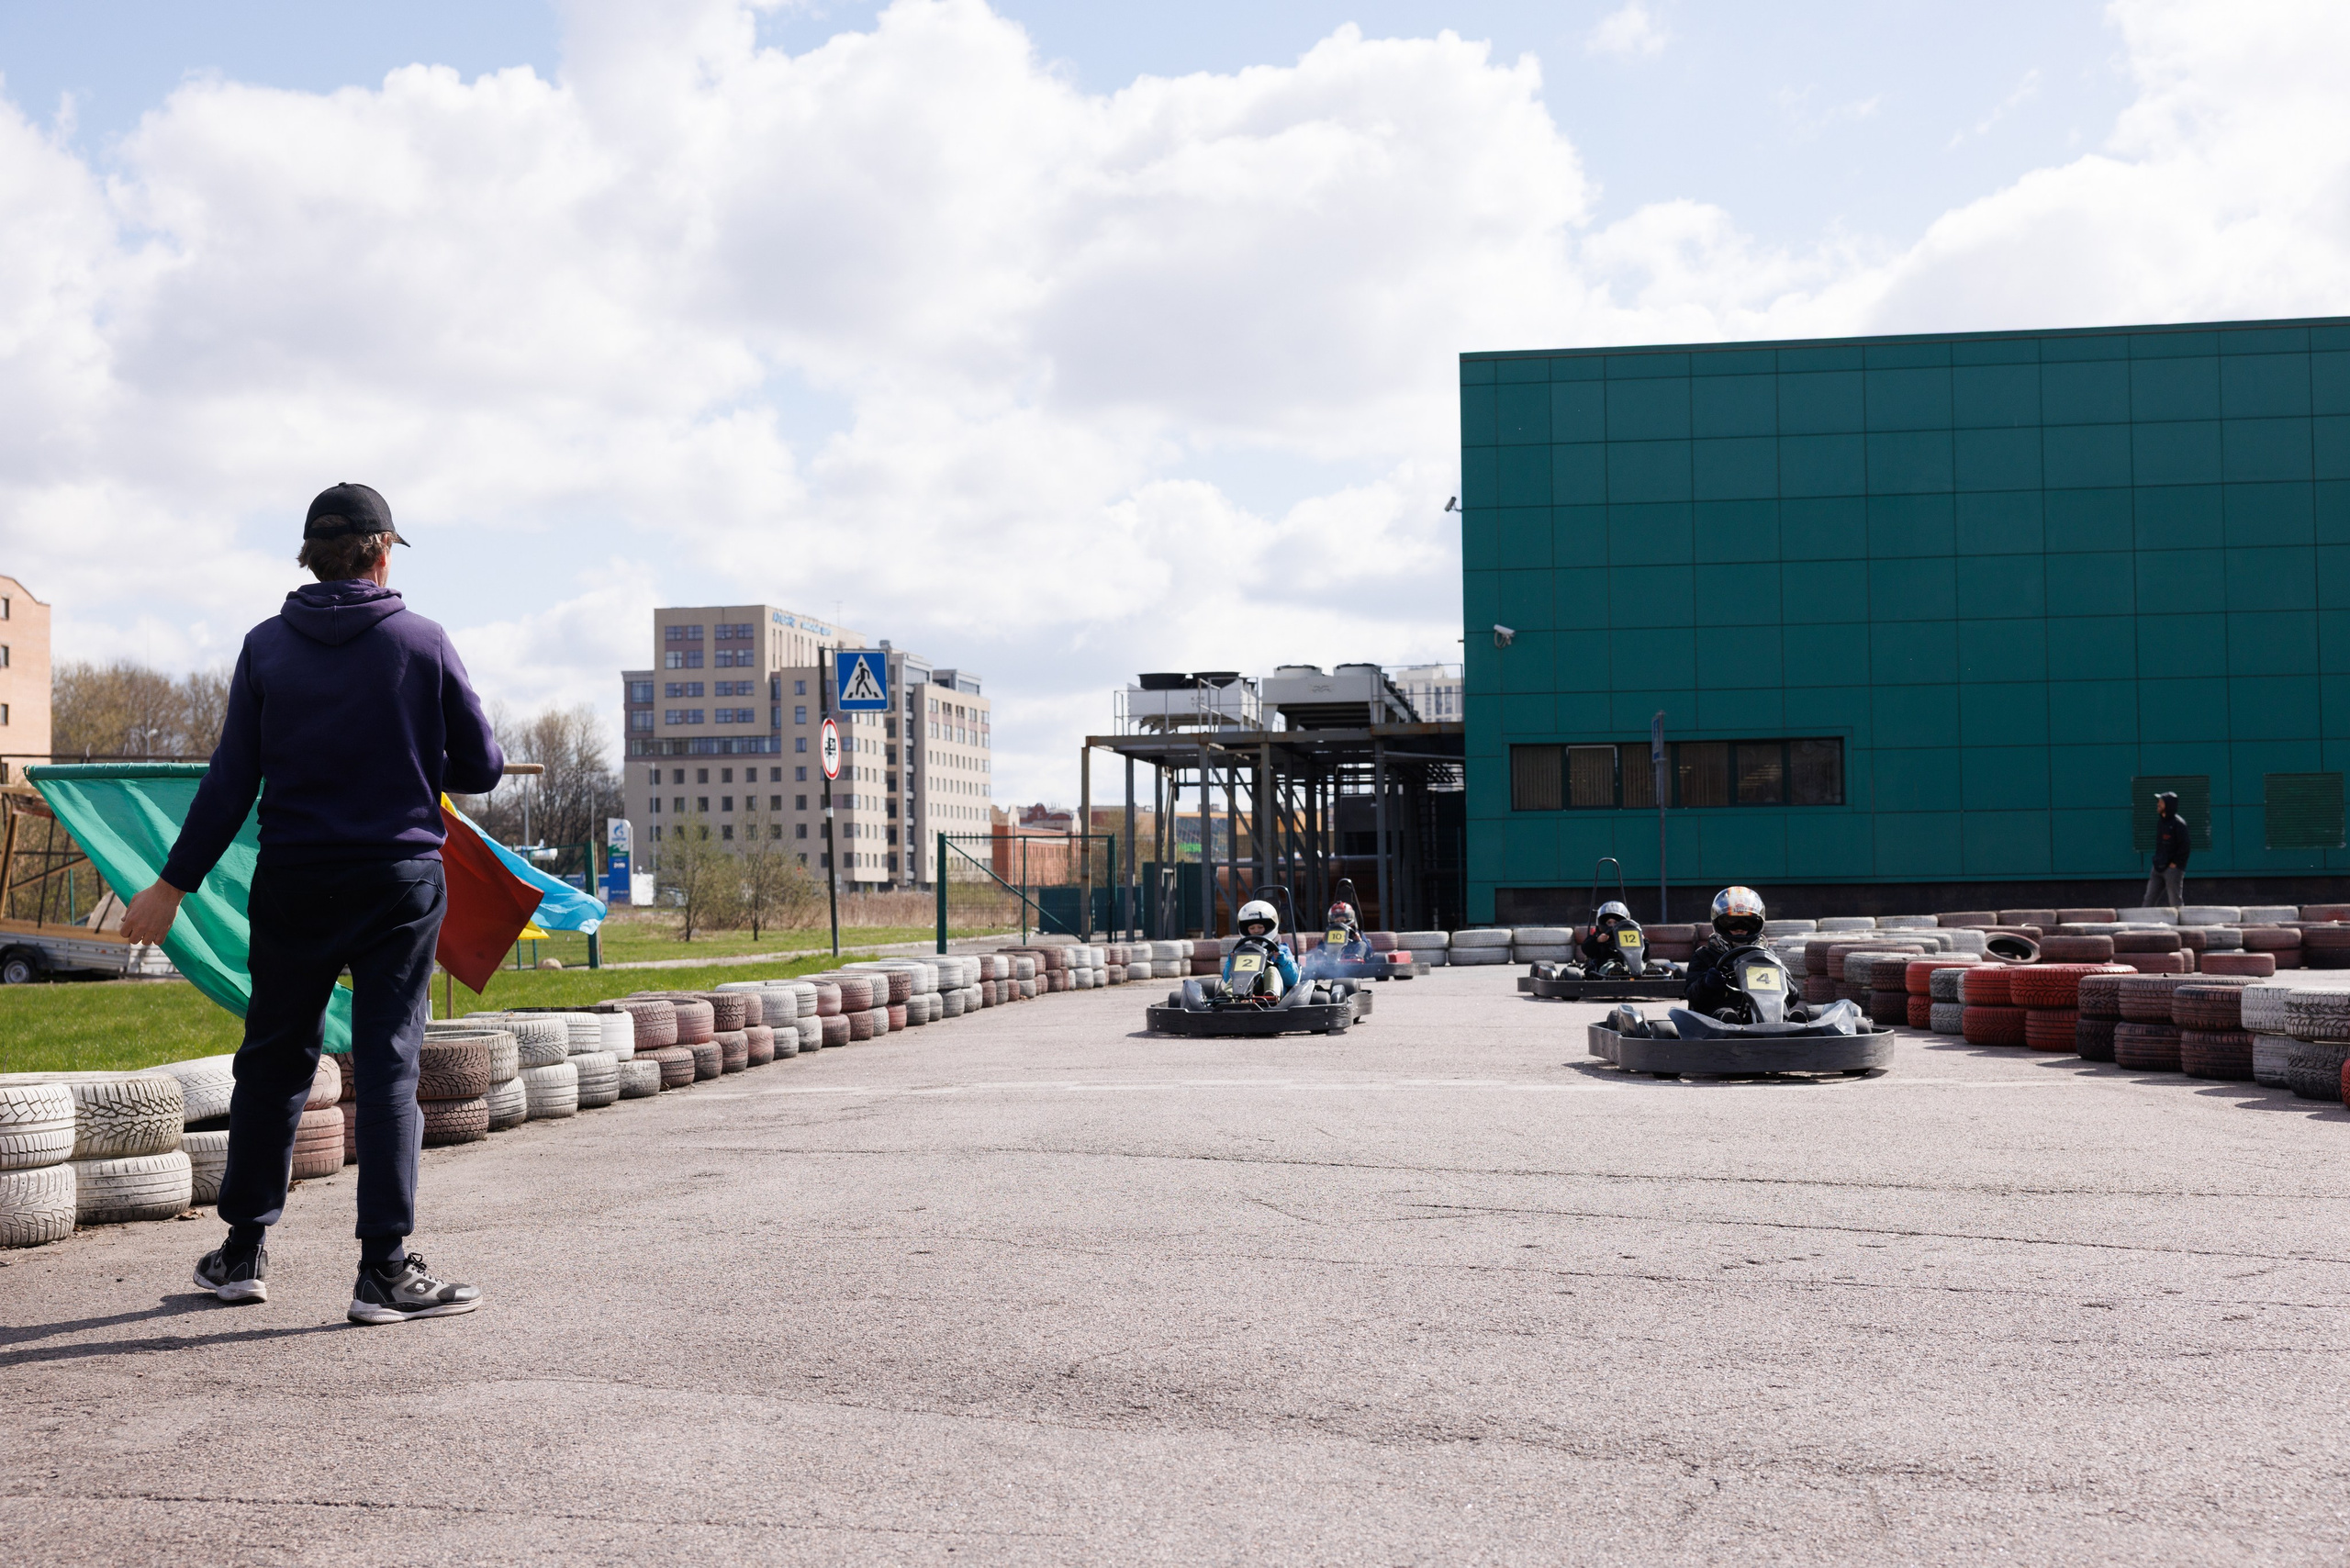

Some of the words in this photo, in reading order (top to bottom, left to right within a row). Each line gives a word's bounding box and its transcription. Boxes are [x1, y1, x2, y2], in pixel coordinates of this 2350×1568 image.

[1623, 934, 1637, 944] 12
[1242, 958, 1253, 968] 2
[1756, 972, 1771, 984] 4
